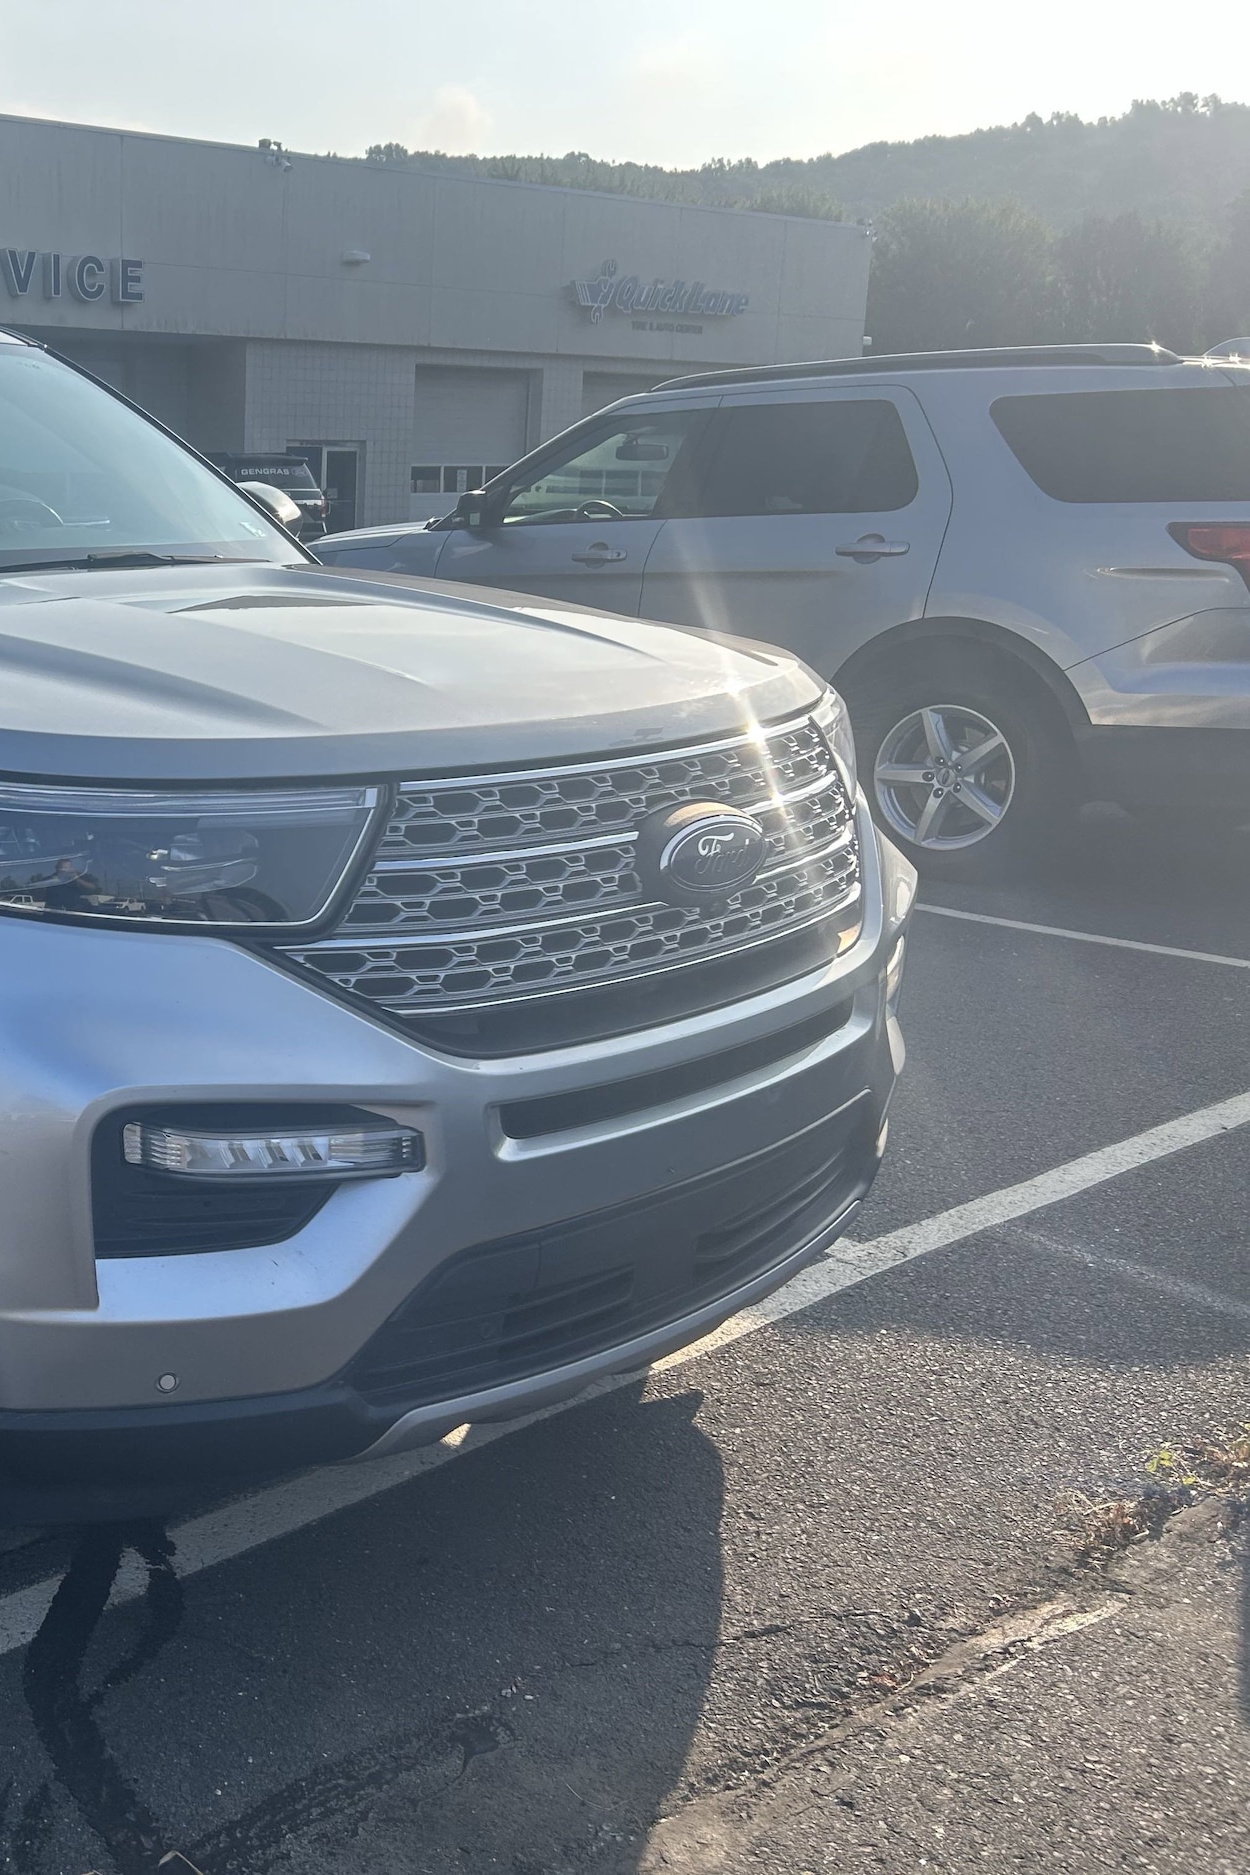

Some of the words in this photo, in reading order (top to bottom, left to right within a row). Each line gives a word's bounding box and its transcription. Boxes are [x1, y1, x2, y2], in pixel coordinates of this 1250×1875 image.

[616, 276, 688, 314] Quick
[688, 281, 750, 317] Lane
[240, 468, 290, 476] GENGRAS
[694, 832, 750, 875] Ford
